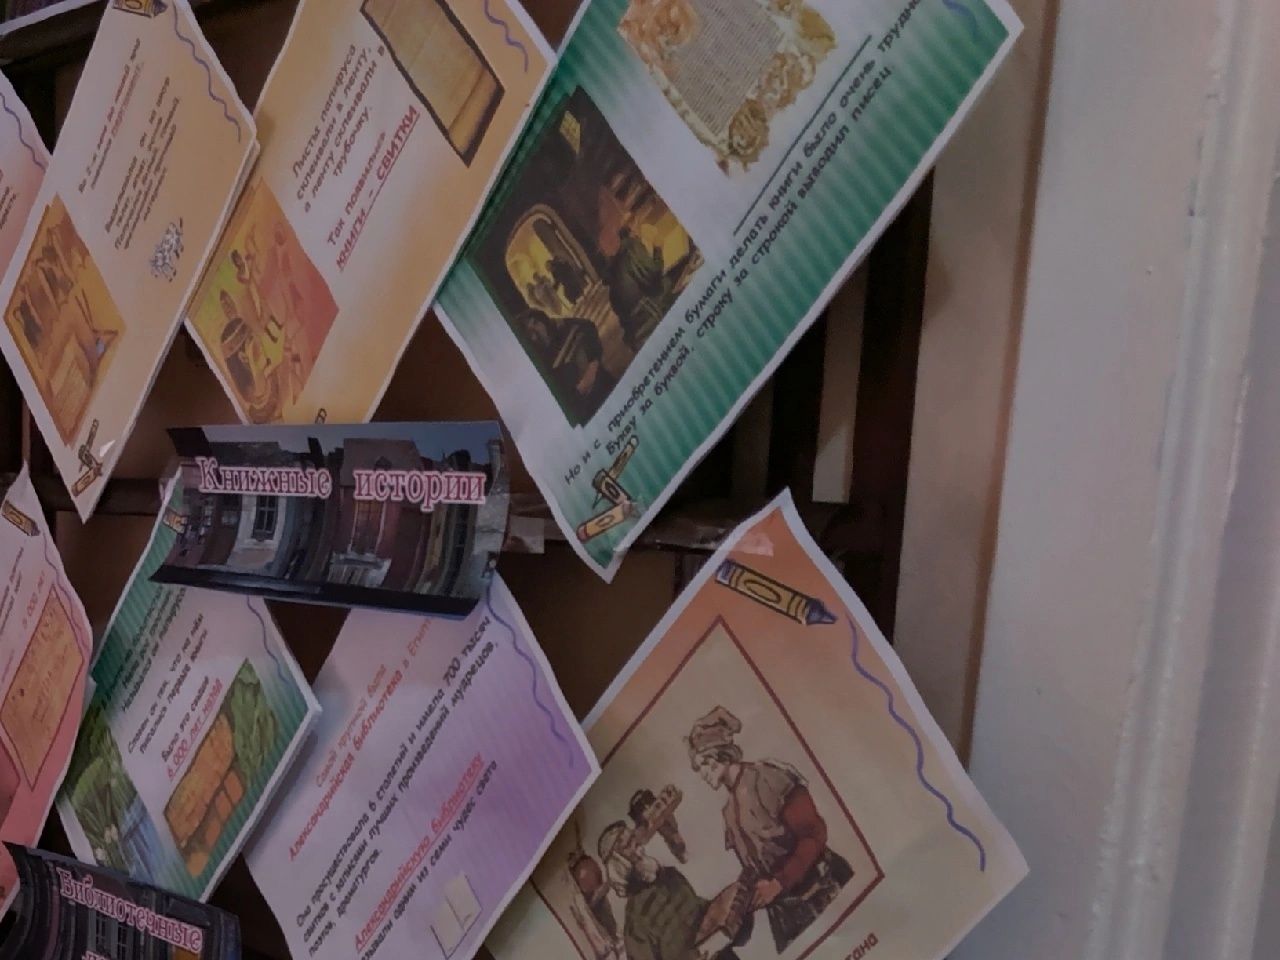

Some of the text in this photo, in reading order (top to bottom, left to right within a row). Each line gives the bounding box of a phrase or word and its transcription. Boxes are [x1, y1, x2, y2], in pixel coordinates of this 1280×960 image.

[293, 45, 356, 177] Листы папируса
[296, 117, 335, 200] склеивали
[303, 198, 311, 214] а
[311, 150, 336, 198] ленту
[334, 61, 376, 147] склеивали
[327, 132, 385, 251] Так появились
[335, 209, 366, 269] книги
[376, 104, 417, 182] СВИТКИ
[561, 463, 582, 485] Но
[578, 450, 593, 463] и
[591, 439, 602, 449] с
[607, 326, 685, 432] приобретением
[681, 267, 730, 326] бумаги
[725, 212, 771, 269] делать
[765, 160, 805, 209] книги
[799, 110, 838, 158] было
[836, 57, 877, 109] очень
[602, 413, 639, 455] Букву
[636, 397, 653, 415] за
[693, 288, 736, 339] строку
[731, 267, 748, 286] за
[745, 198, 800, 265] строкой
[793, 124, 851, 199] выводил
[196, 457, 486, 512] Книжные истории
[171, 737, 189, 766] 000
[290, 753, 354, 861] Александрийская
[354, 673, 403, 752] библиотека
[295, 899, 311, 929] Она
[310, 814, 370, 908] просуществовала
[373, 740, 409, 801] столетий
[408, 730, 416, 745] и
[416, 686, 444, 733] имела
[441, 653, 461, 689] 700
[461, 615, 491, 661] тысяч
[302, 899, 329, 945] свитков
[368, 791, 399, 844] лучших
[395, 702, 451, 796] произведений
[428, 831, 451, 868] семи
[451, 795, 478, 837] чудес
[57, 868, 203, 953] Библиотечные
